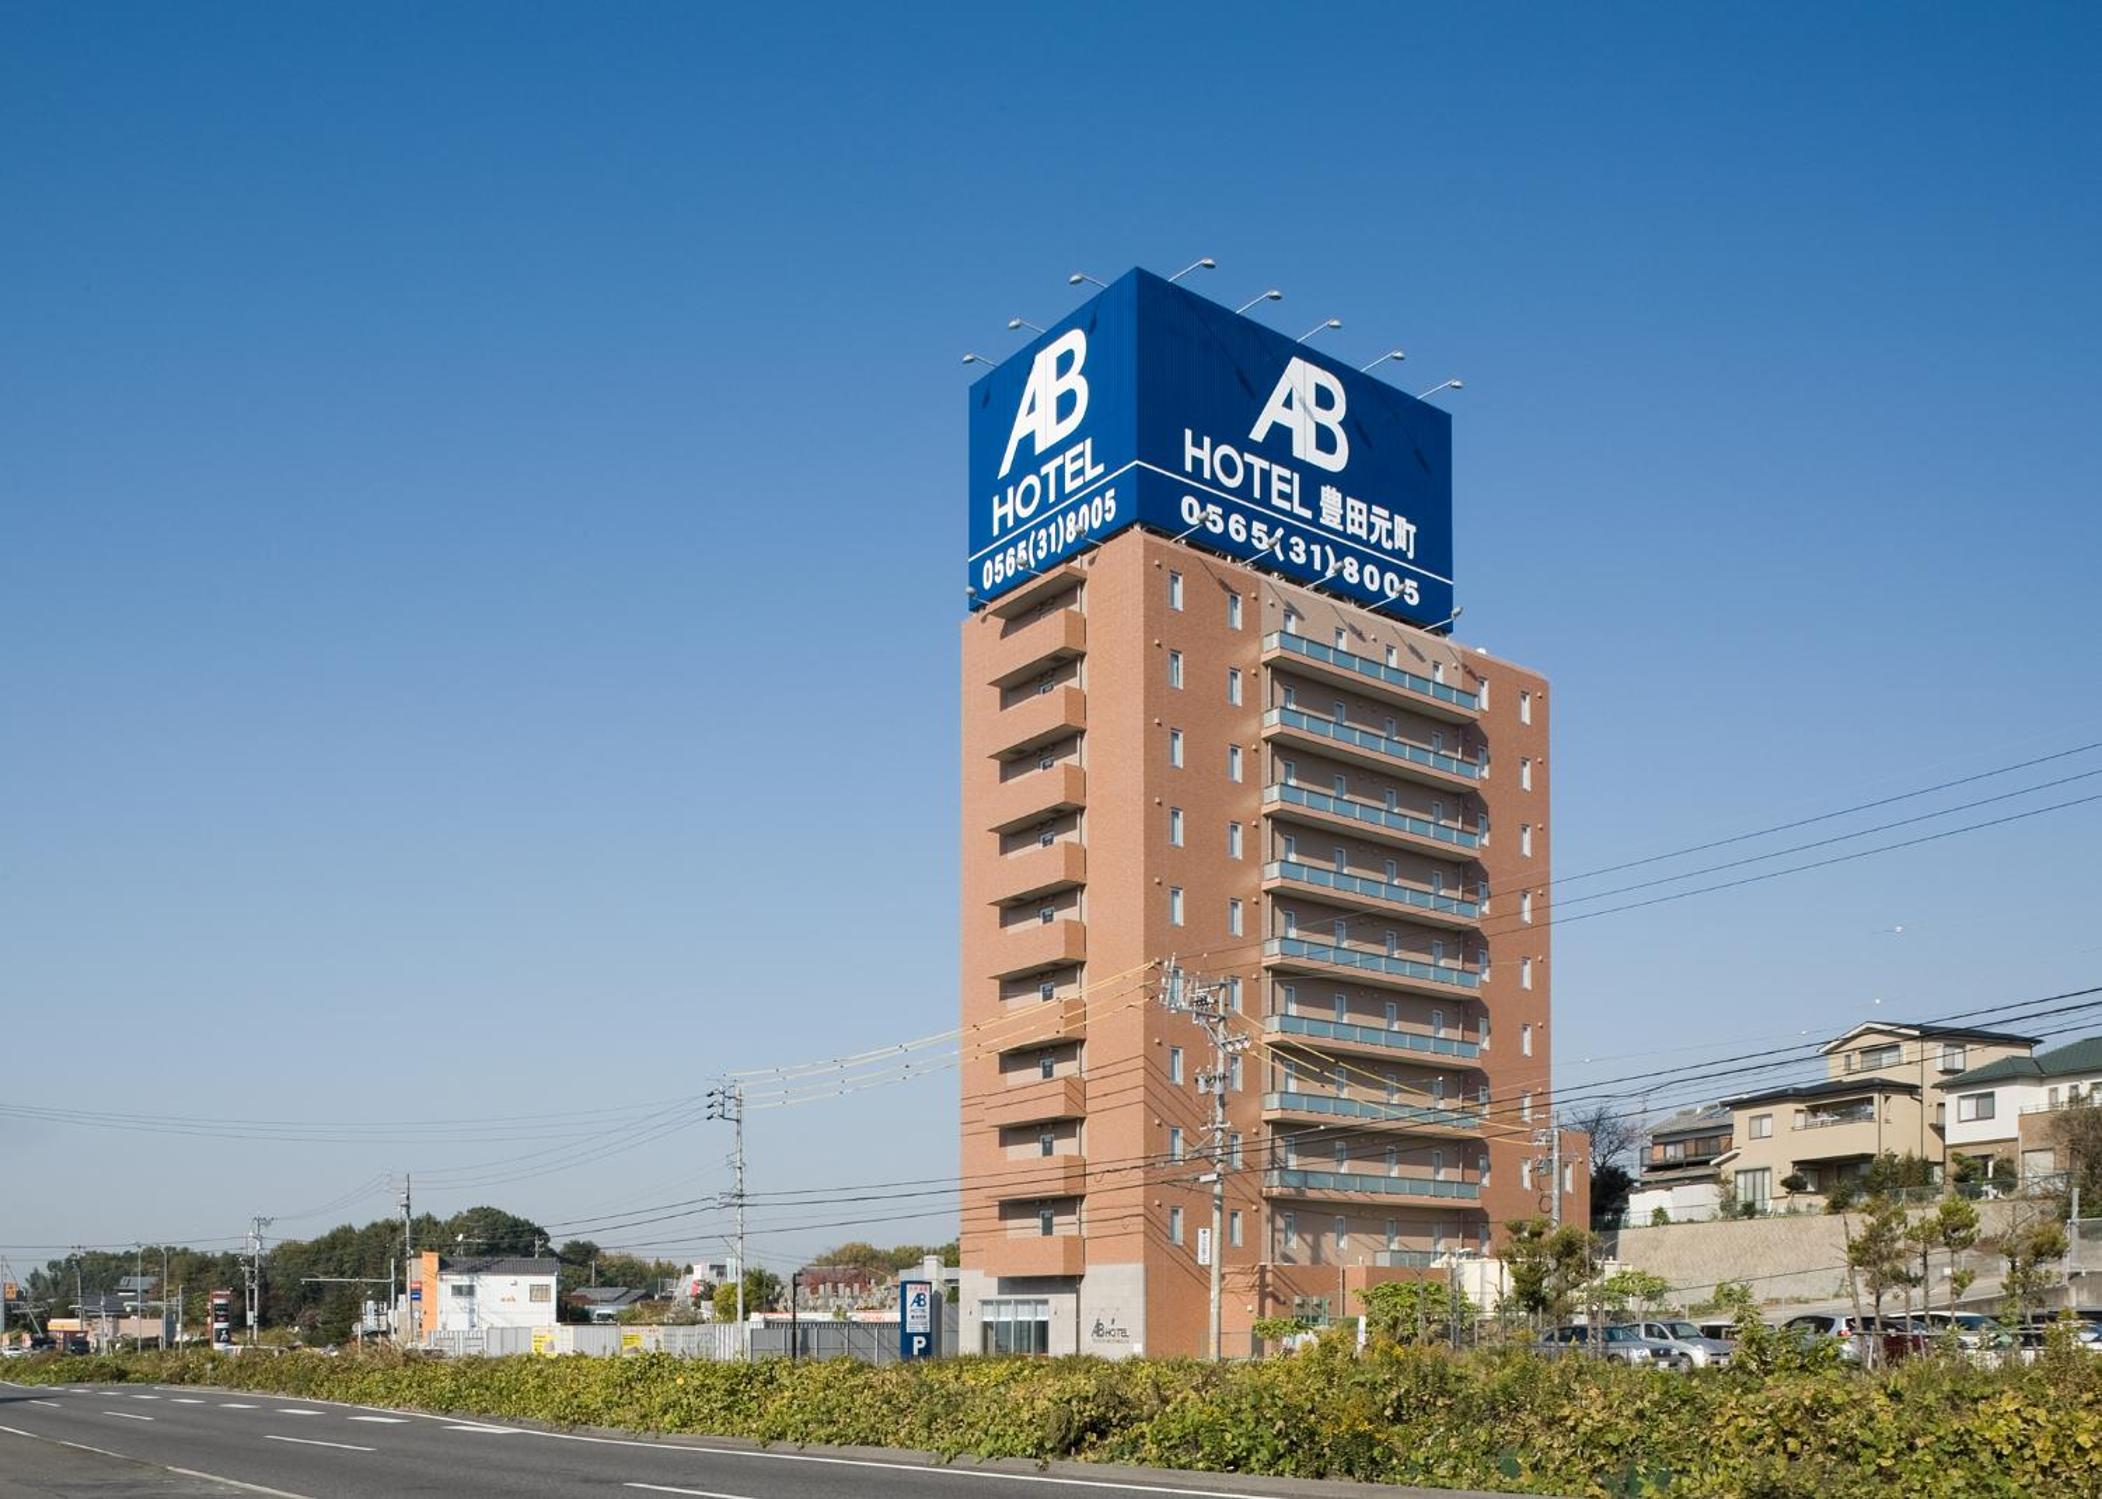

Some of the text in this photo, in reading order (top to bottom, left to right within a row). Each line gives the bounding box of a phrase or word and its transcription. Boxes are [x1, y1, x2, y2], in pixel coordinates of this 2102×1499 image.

[998, 329, 1089, 479] AB
[1248, 356, 1350, 473] AB
[993, 437, 1105, 537] HOTEL
[1184, 428, 1417, 560] HOTEL 豊田元町
[913, 1336, 927, 1355] P
